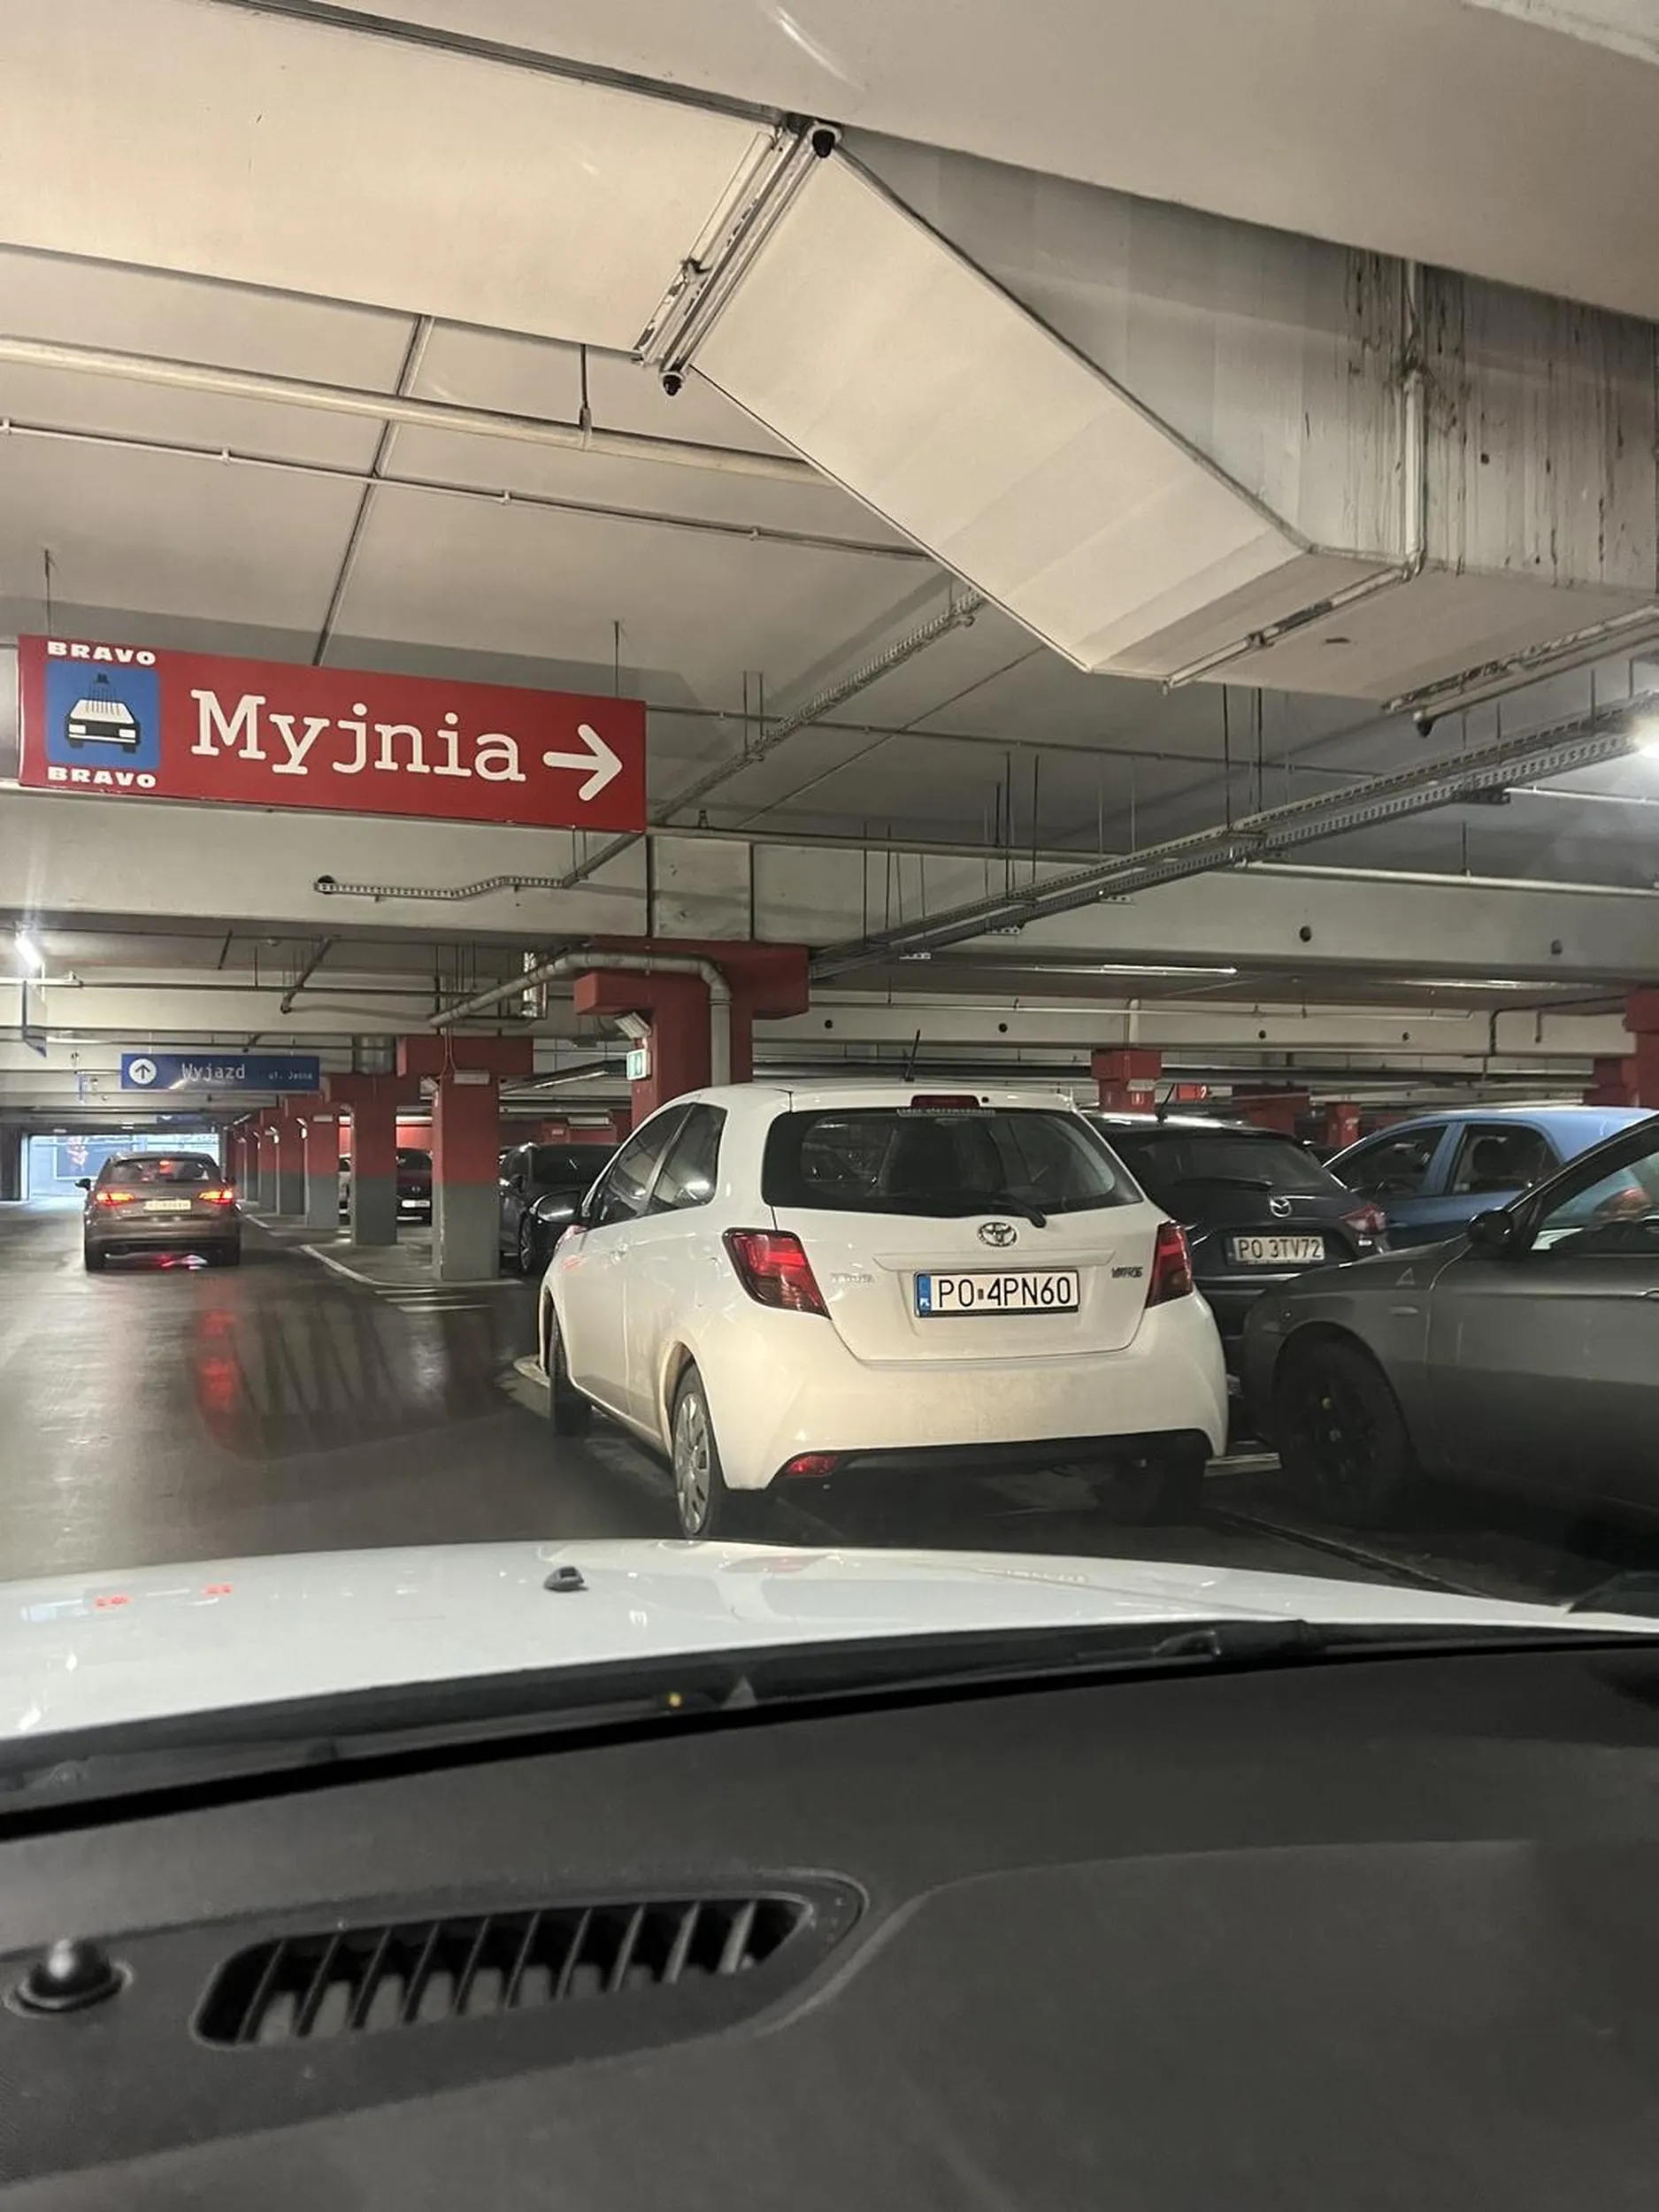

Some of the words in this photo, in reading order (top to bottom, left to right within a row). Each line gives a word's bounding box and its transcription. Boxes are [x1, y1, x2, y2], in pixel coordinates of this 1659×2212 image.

[47, 641, 156, 666] BRAVO
[190, 689, 526, 782] Myjnia
[48, 766, 157, 788] BRAVO
[181, 1063, 245, 1082] Wyjazd
[1239, 1239, 1263, 1258] PO
[1269, 1239, 1321, 1258] 3TV72
[939, 1279, 974, 1308] PO
[987, 1277, 1071, 1306] 4PN60
